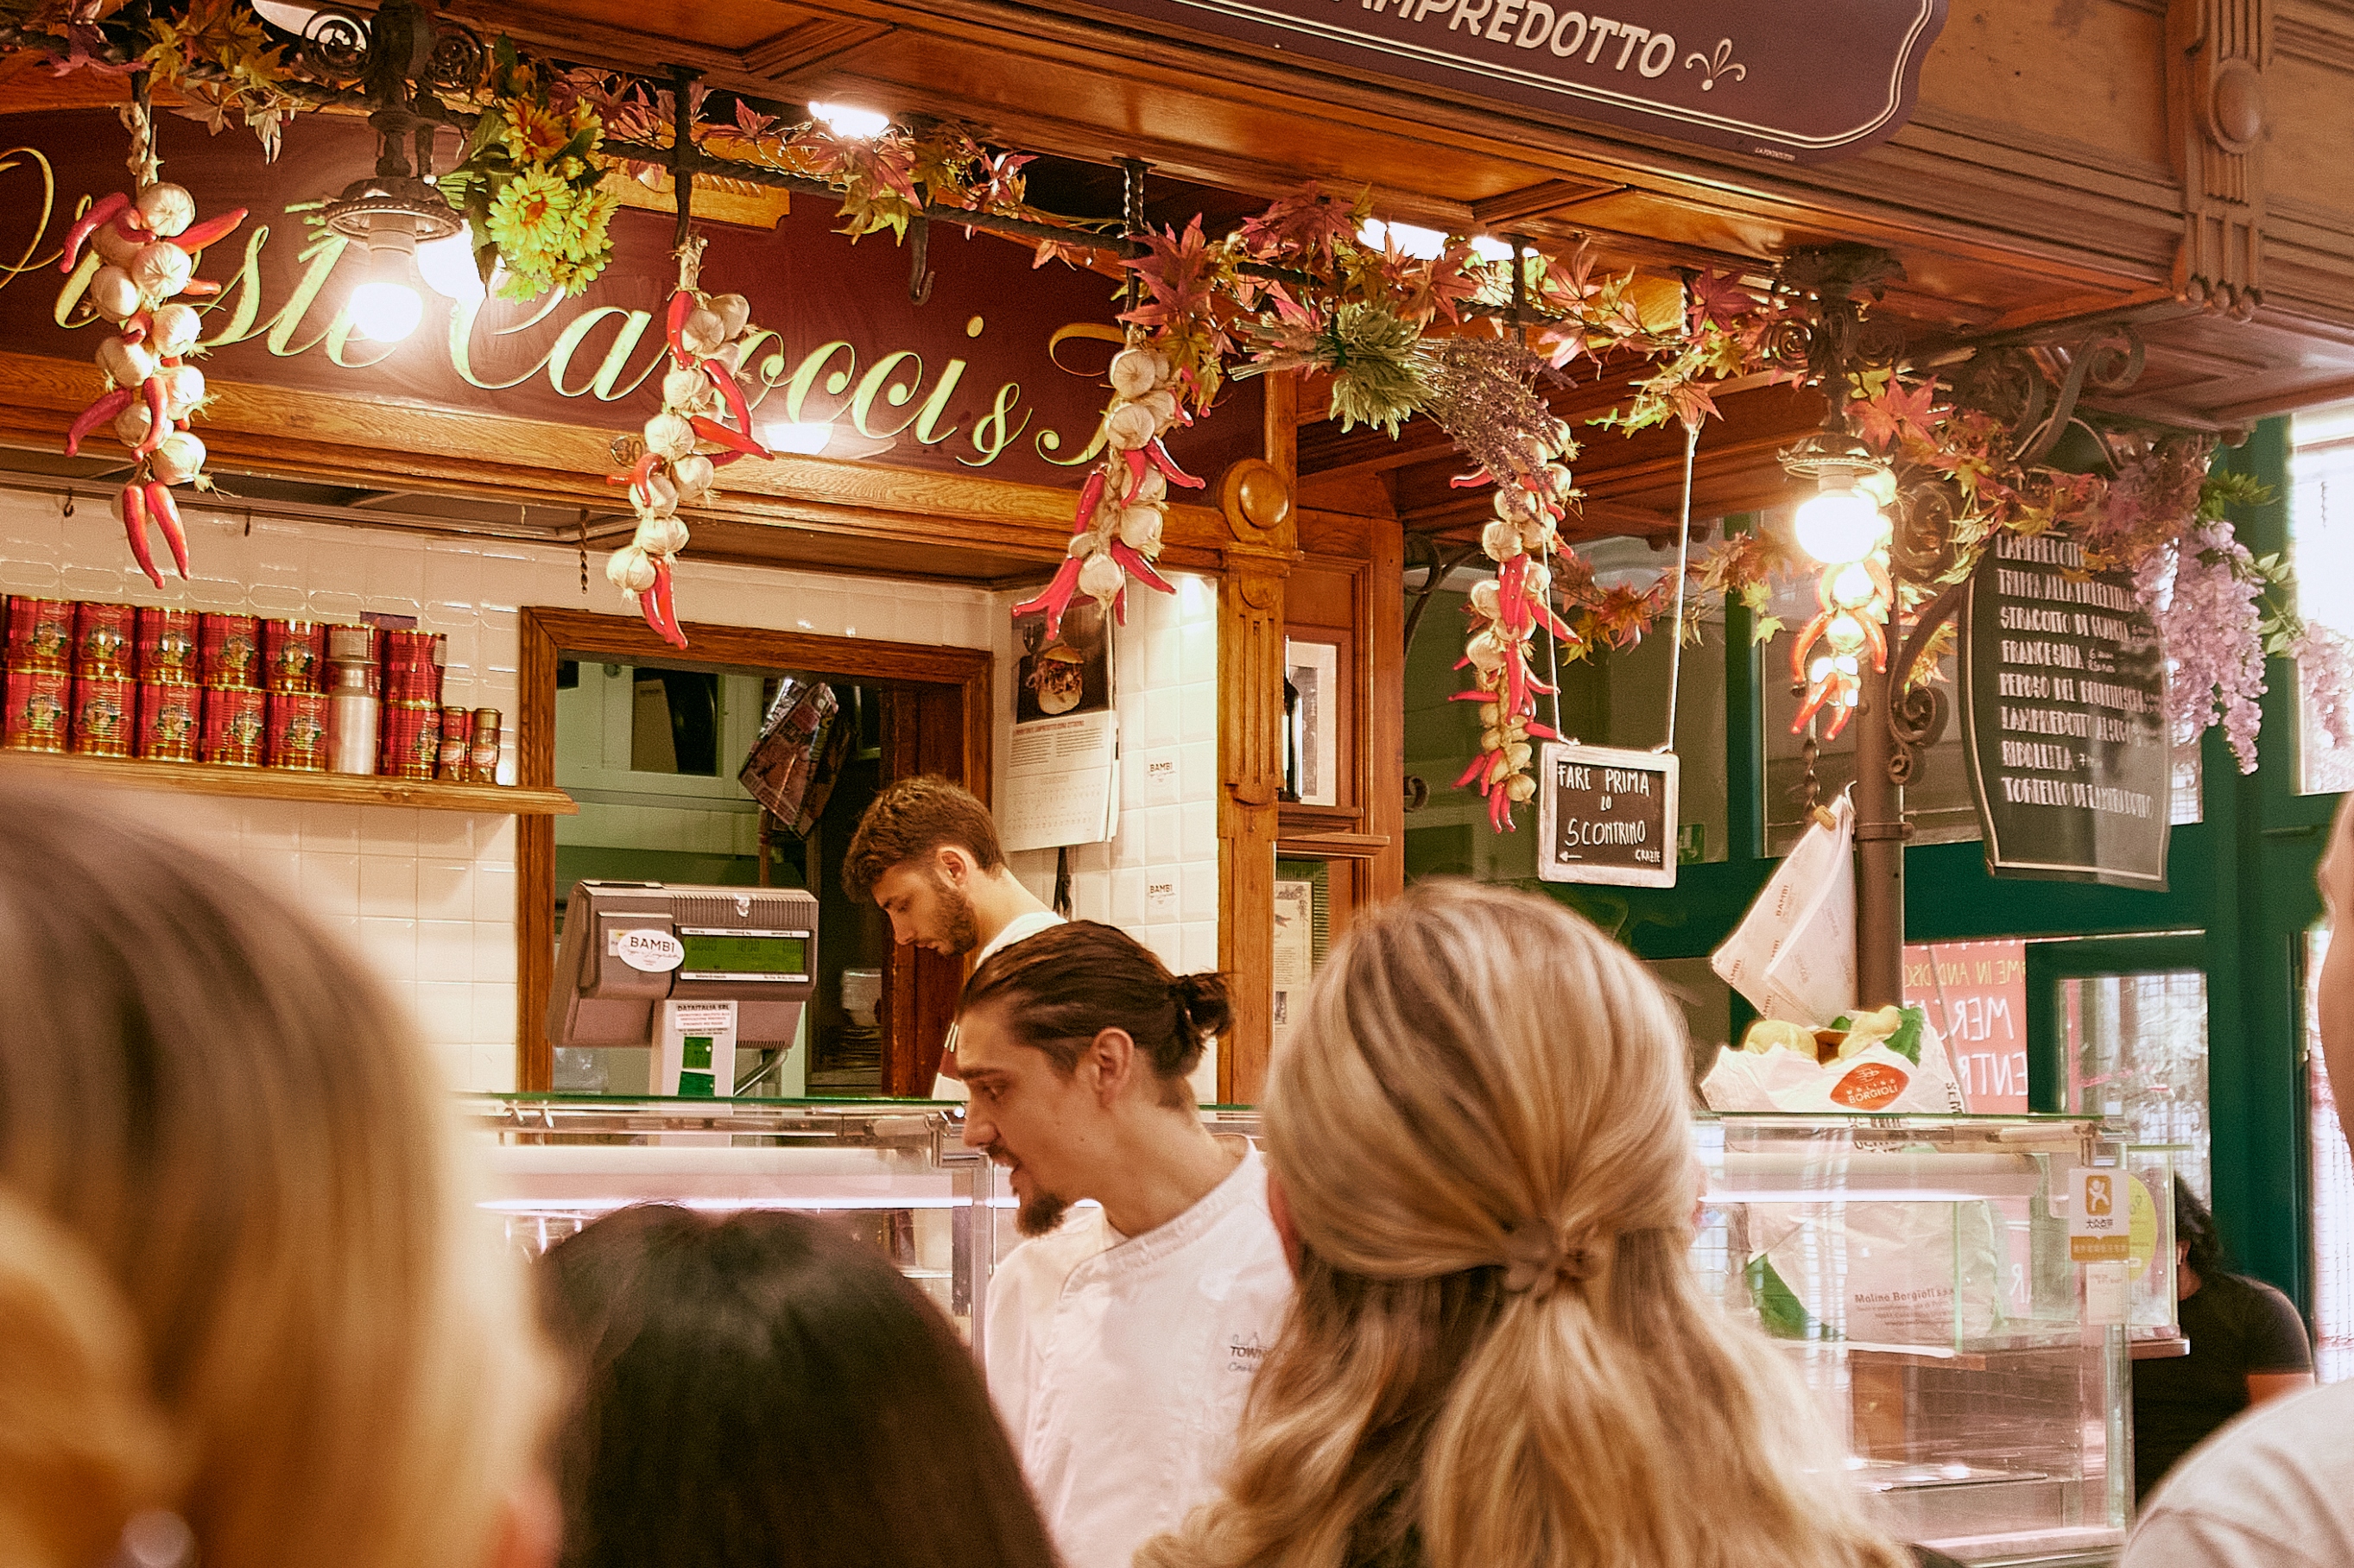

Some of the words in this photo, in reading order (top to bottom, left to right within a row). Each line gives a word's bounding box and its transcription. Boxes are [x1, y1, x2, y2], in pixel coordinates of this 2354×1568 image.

[1357, 0, 1676, 79] PREDOTTO
[2001, 640, 2085, 670] FRANCESINA
[1149, 762, 1173, 772] BAMBI
[1558, 764, 1591, 791] FARE
[1604, 768, 1650, 797] PRIMA
[1600, 795, 1612, 812] LO
[1564, 817, 1647, 847] SCONTRINO
[1149, 883, 1173, 894] BAMBI
[630, 936, 675, 953] BAMBI
[1848, 1084, 1899, 1104] BORGIOLI
[1854, 1293, 1890, 1304] Molino
[1892, 1287, 1934, 1302] Borgioli
